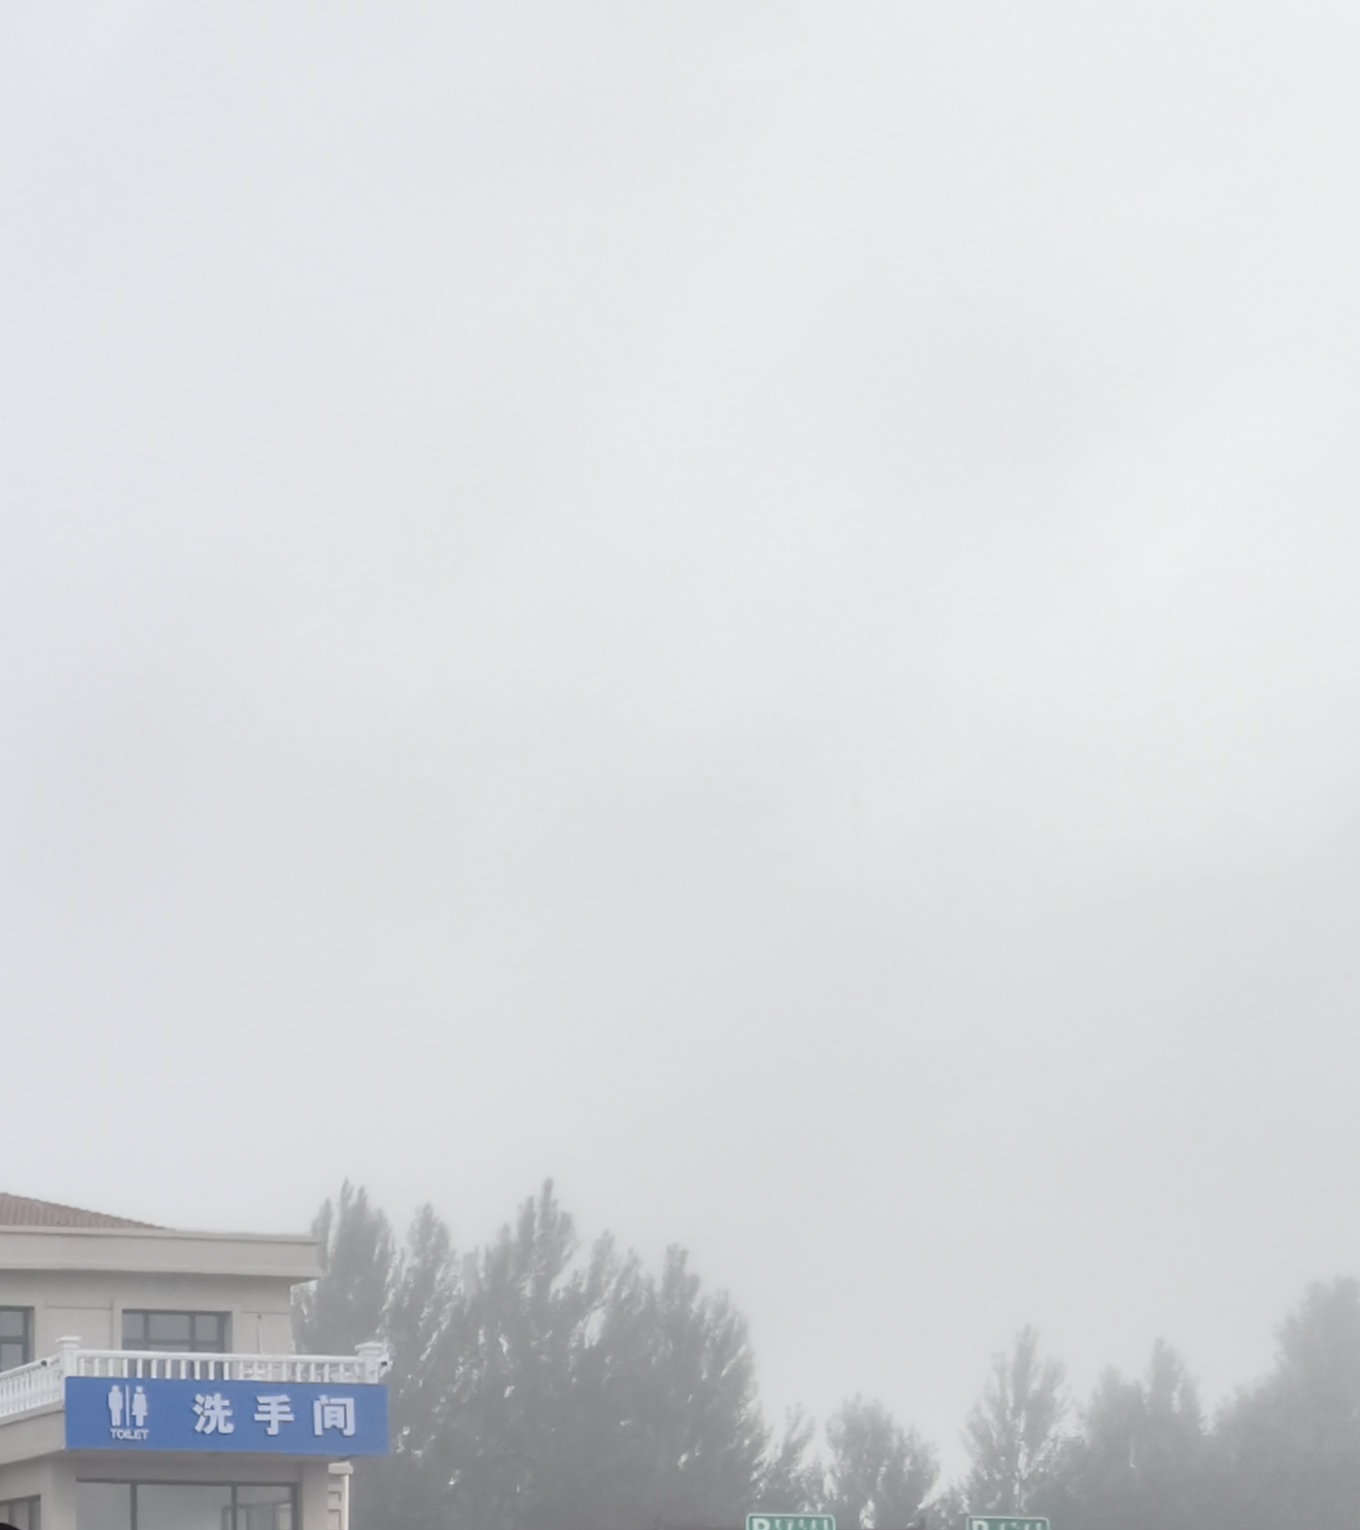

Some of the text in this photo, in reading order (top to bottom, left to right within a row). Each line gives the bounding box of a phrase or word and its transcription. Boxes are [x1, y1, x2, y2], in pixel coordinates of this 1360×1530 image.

[192, 1393, 356, 1437] 洗手间
[110, 1428, 149, 1440] TOILET
